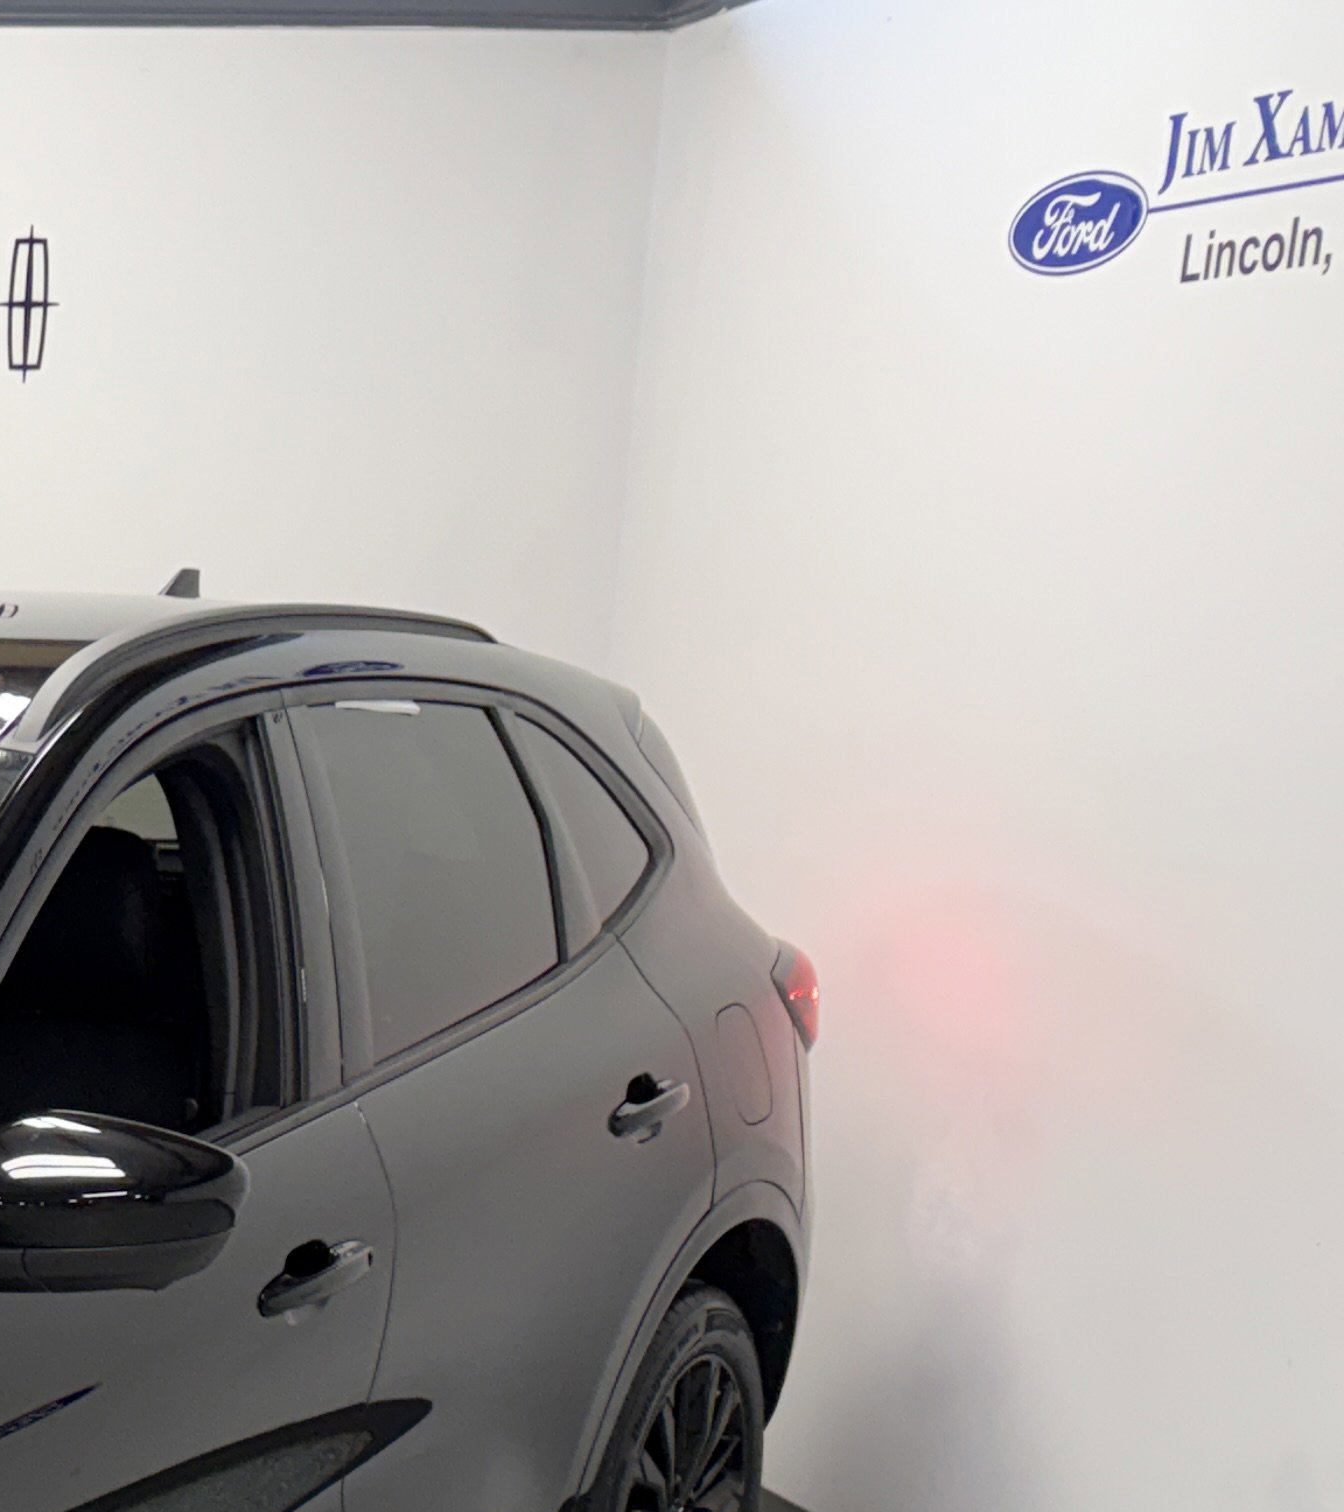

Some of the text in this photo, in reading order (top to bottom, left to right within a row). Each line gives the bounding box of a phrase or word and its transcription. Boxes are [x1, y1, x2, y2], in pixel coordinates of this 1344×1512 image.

[1158, 112, 1237, 196] JIM
[1032, 191, 1121, 261] Ford
[1180, 216, 1333, 284] Lincoln,
